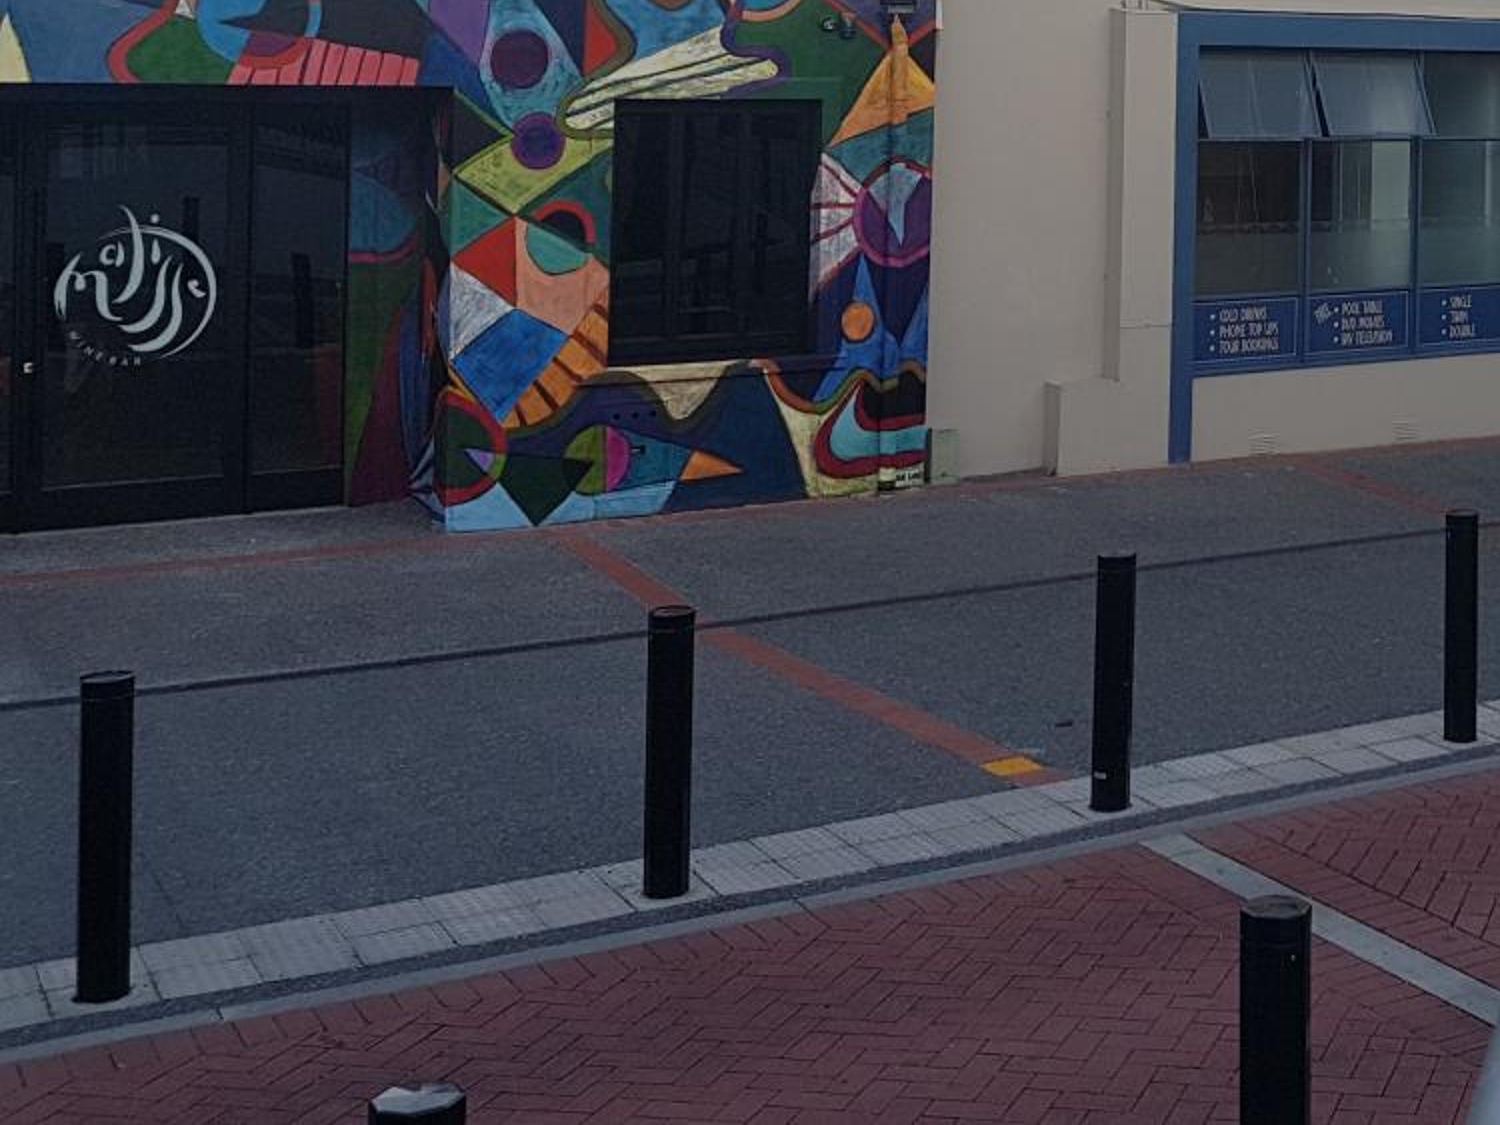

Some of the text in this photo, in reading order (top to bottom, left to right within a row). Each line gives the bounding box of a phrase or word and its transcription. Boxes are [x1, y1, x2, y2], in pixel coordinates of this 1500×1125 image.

[1219, 308, 1238, 322] COLD
[1341, 301, 1360, 315] POOL
[1219, 321, 1279, 338] PHONE TOP UPS
[1219, 339, 1240, 354] TOUR
[109, 355, 141, 366] BAR
